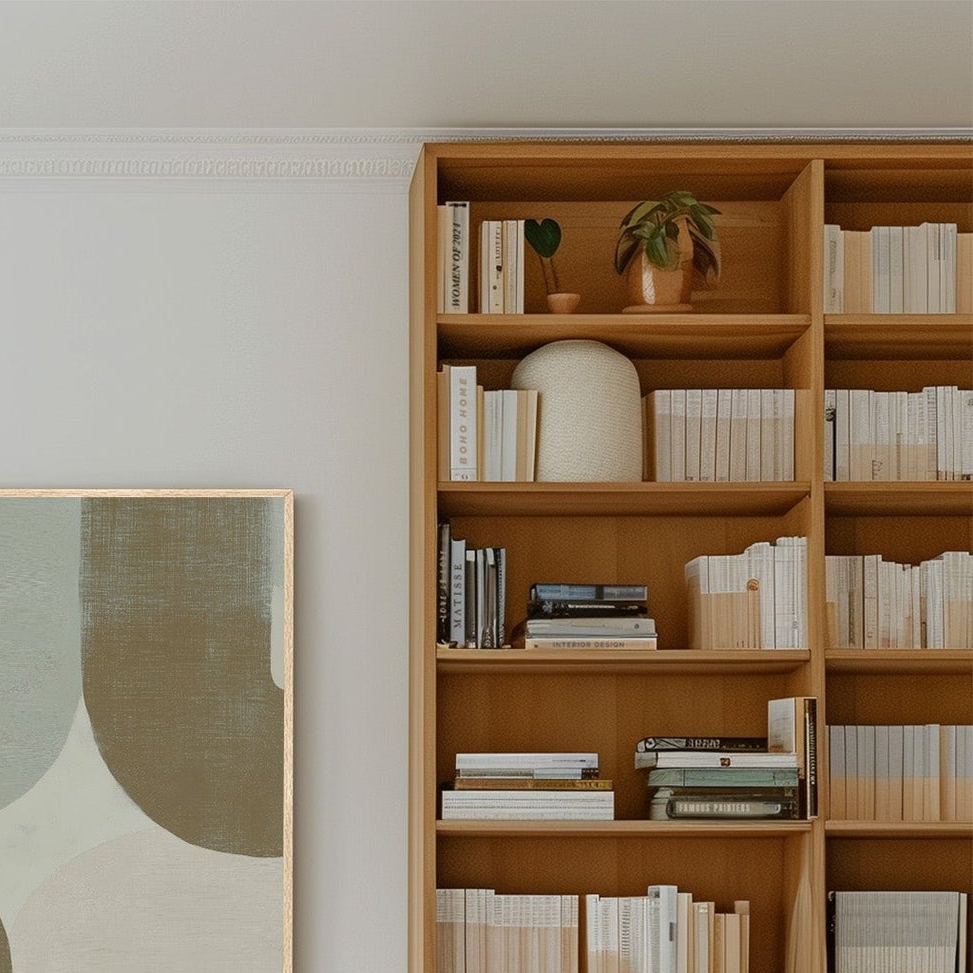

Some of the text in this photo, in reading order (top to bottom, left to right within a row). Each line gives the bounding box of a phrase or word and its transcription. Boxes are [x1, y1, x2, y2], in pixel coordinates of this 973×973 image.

[451, 222, 461, 307] WOMEN OF 2024
[458, 377, 468, 418] HOME
[458, 424, 468, 465] BOHO
[453, 563, 462, 628] MATISSE
[678, 803, 750, 812] FAMOUS PAINTERS
